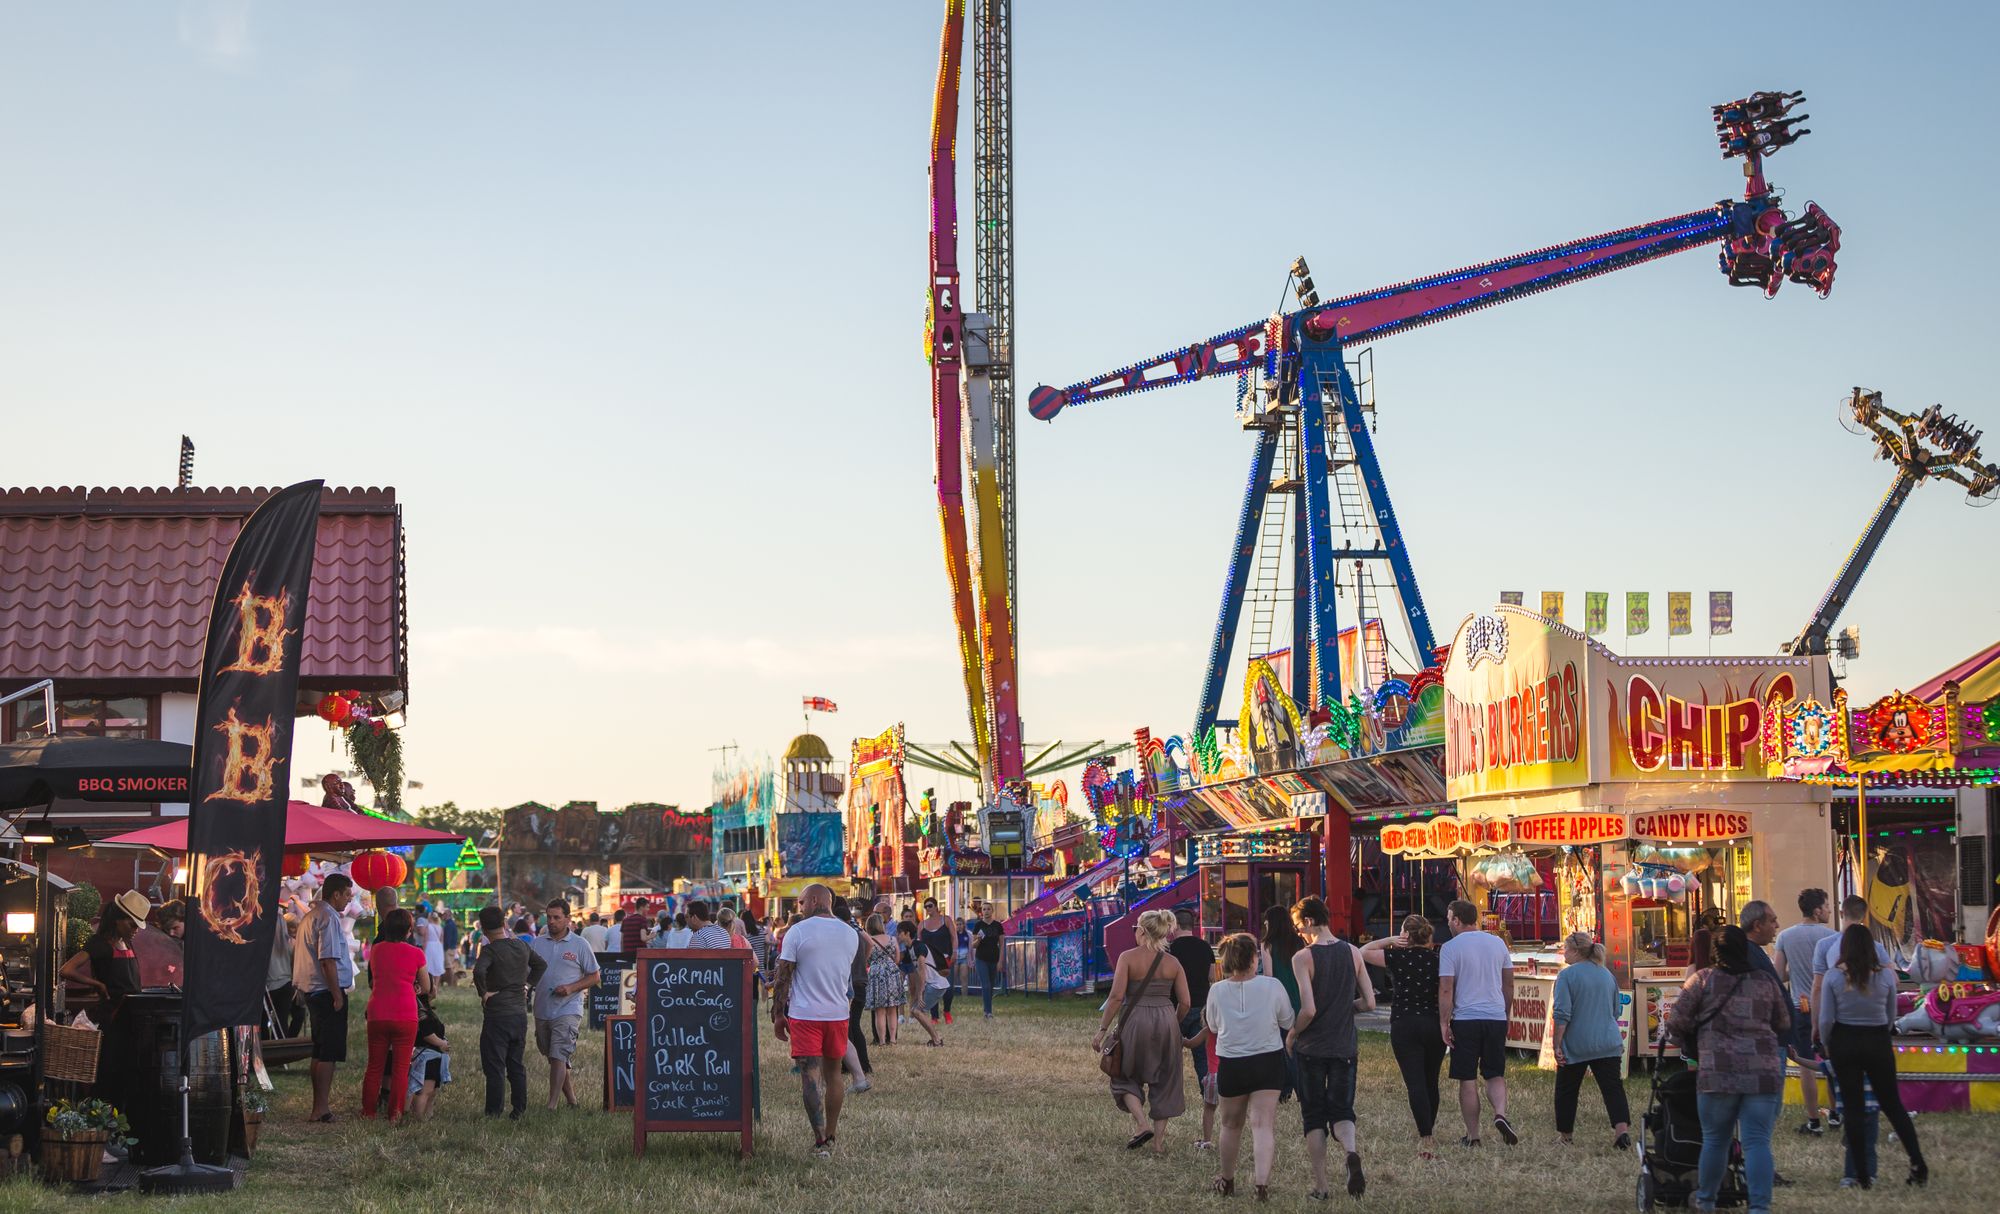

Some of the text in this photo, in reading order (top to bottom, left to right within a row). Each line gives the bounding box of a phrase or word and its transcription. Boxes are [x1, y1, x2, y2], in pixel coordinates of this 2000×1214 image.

[1488, 661, 1579, 770] BURGERS
[78, 777, 187, 792] BBQ SMOKER
[1514, 817, 1565, 840] TOFFEE
[1569, 816, 1623, 840] APPLES
[1635, 813, 1747, 838] CANDY FLOSS
[1512, 999, 1546, 1020] BURGERS
[650, 1014, 709, 1047] Pulled
[704, 1049, 730, 1076] Roll
